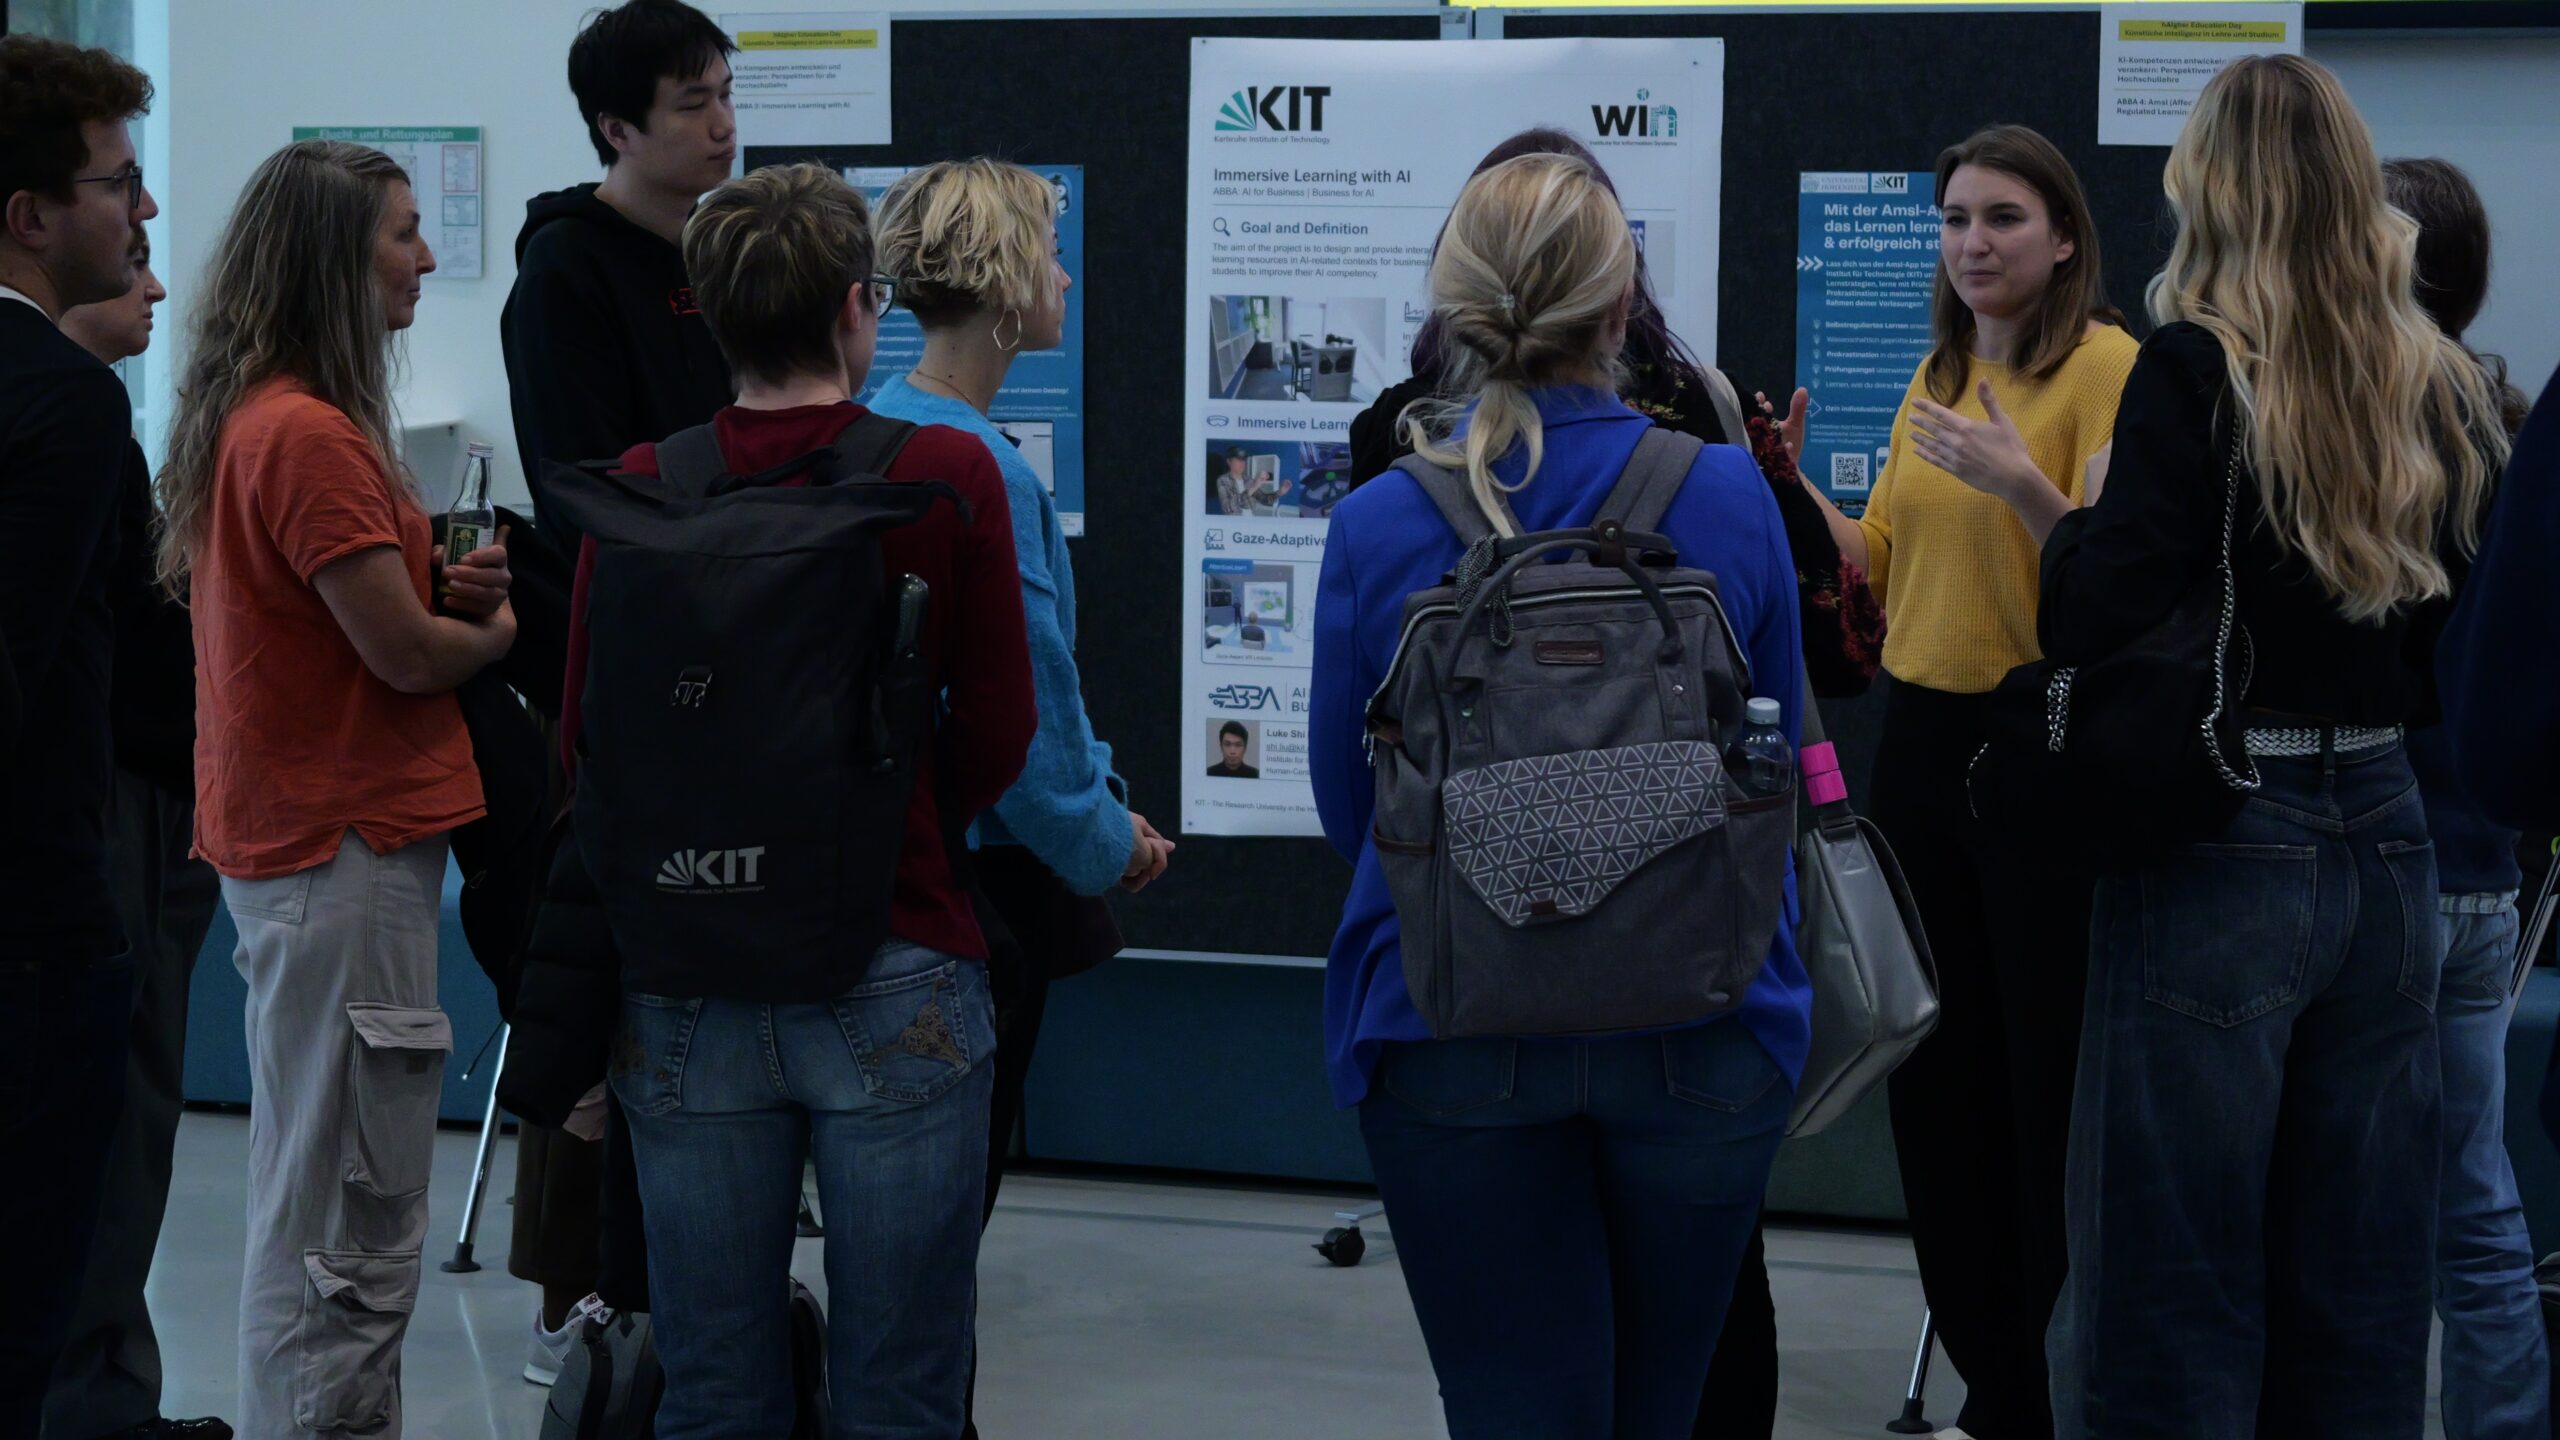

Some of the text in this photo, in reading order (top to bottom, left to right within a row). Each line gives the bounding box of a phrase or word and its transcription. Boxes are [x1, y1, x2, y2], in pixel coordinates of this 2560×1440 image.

[2190, 22, 2227, 30] Education
[2228, 23, 2243, 31] Day
[2233, 31, 2248, 39] und
[2118, 57, 2183, 65] KI-Kompetenzen
[2160, 66, 2212, 75] Perspektiven
[2117, 75, 2180, 83] Hochschullehre
[798, 102, 826, 110] Learning
[1248, 86, 1332, 131] KIT
[2117, 108, 2156, 116] Regulated
[359, 130, 380, 139] und
[383, 128, 454, 142] Rettungsplan
[1214, 135, 1248, 143] Karlsruhe
[1290, 136, 1331, 145] Technology
[1213, 168, 1411, 185] Immersive Learning with AI
[1883, 176, 1906, 188] KIT
[1242, 187, 1251, 196] AI
[1253, 188, 1264, 196] for
[1267, 187, 1305, 197] Business
[1312, 188, 1350, 197] Business
[1352, 188, 1364, 197] for
[1365, 189, 1375, 197] AI
[1824, 203, 1878, 216] Mit der
[1241, 222, 1369, 235] Goal and Definition
[1824, 220, 1851, 232] das
[1855, 221, 1906, 233] Lernen
[1213, 243, 1403, 255] The aim of the project is to design and provide
[1824, 237, 1941, 252] & erfolgreich st
[1212, 255, 1245, 265] learning
[1300, 256, 1341, 265] AI-related
[1343, 258, 1378, 266] contexts
[1380, 258, 1392, 266] for
[1211, 267, 1247, 276] students
[1248, 268, 1257, 276] to
[1259, 268, 1293, 278] improve
[1295, 268, 1313, 277] their
[1315, 268, 1325, 277] AI
[1864, 271, 1905, 280] Technologie
[1879, 300, 1924, 309] Vorlesungen!
[1885, 321, 1909, 329] Lernen
[1826, 350, 1879, 358] Prokrastination
[1825, 366, 1875, 374] Prüfungsangst
[1237, 416, 1307, 429] Immersive
[1232, 531, 1327, 547] Gaze-Adaptive
[1292, 687, 1306, 698] AI
[1266, 729, 1306, 739] Luke Shi
[1266, 755, 1304, 764] Institute for
[1225, 801, 1255, 809] Research
[1256, 803, 1287, 811] University
[687, 846, 766, 885] KIT
